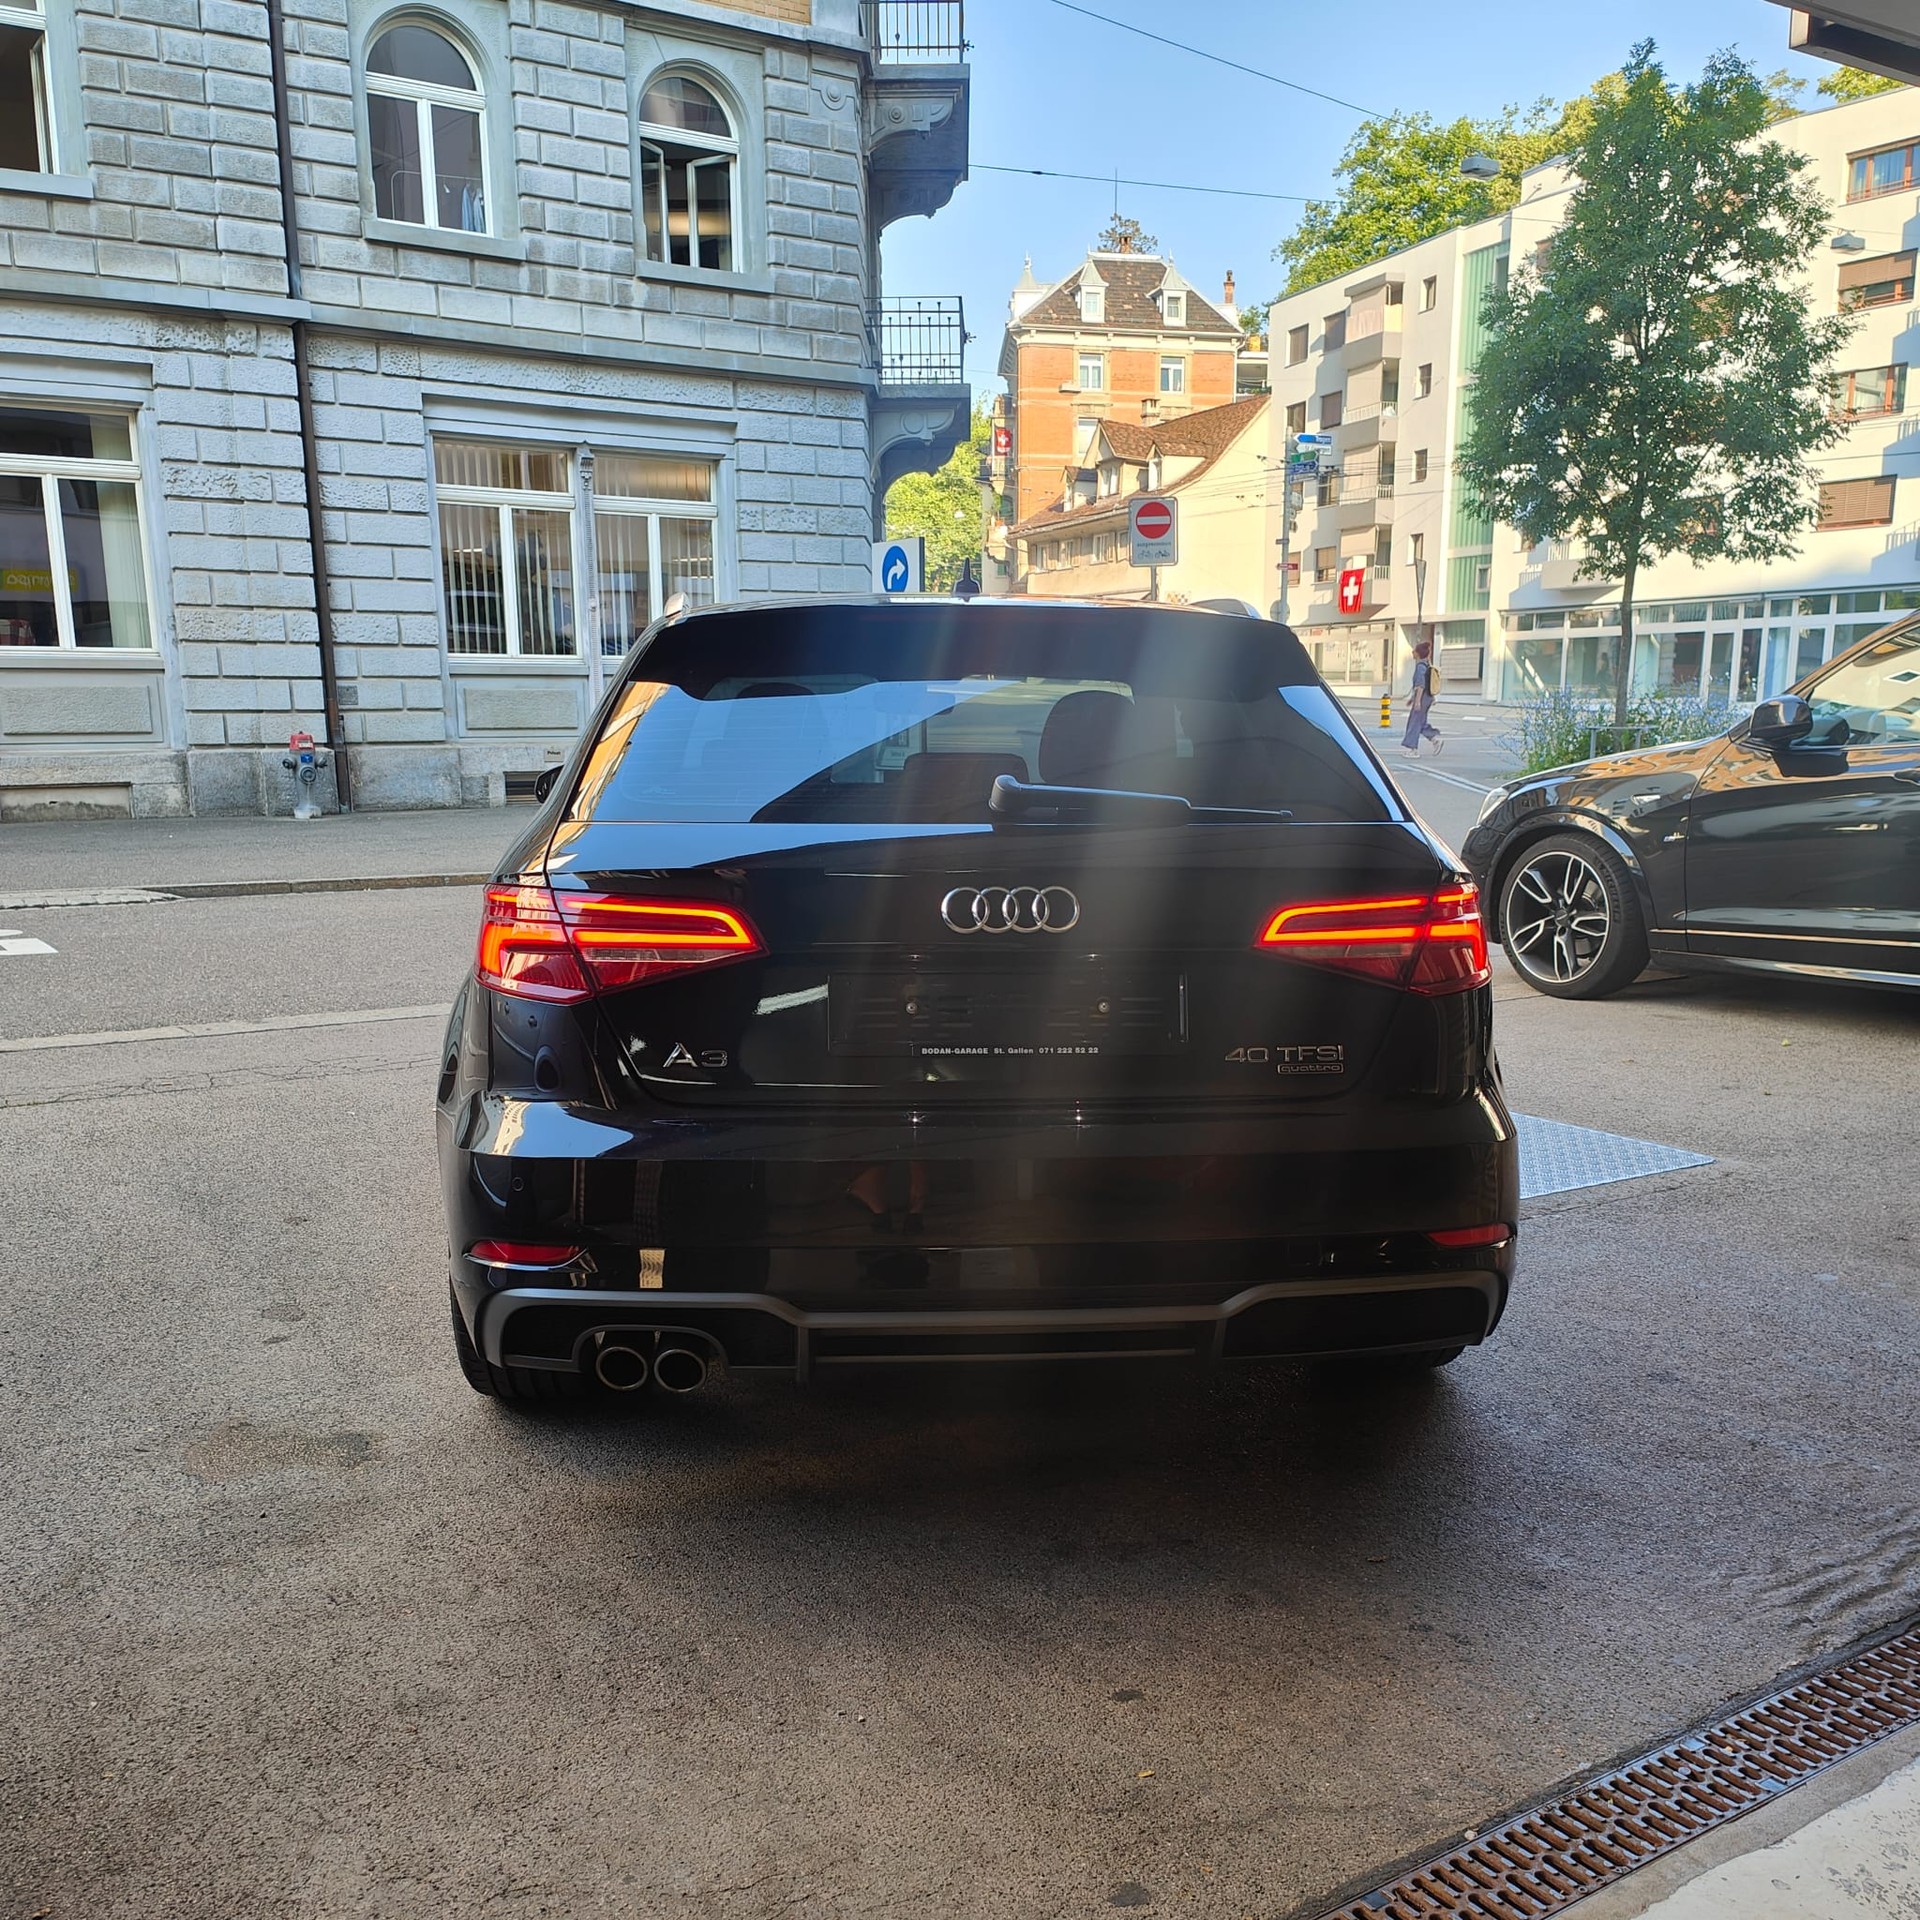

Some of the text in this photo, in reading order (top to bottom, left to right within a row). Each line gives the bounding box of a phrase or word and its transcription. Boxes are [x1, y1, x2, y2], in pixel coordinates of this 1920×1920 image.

[662, 1042, 728, 1068] A3
[921, 1047, 989, 1055] BODAN-GARAGE
[1008, 1047, 1034, 1055] Gallen
[1225, 1045, 1344, 1063] 40 TFSI
[1280, 1064, 1341, 1074] quattro
